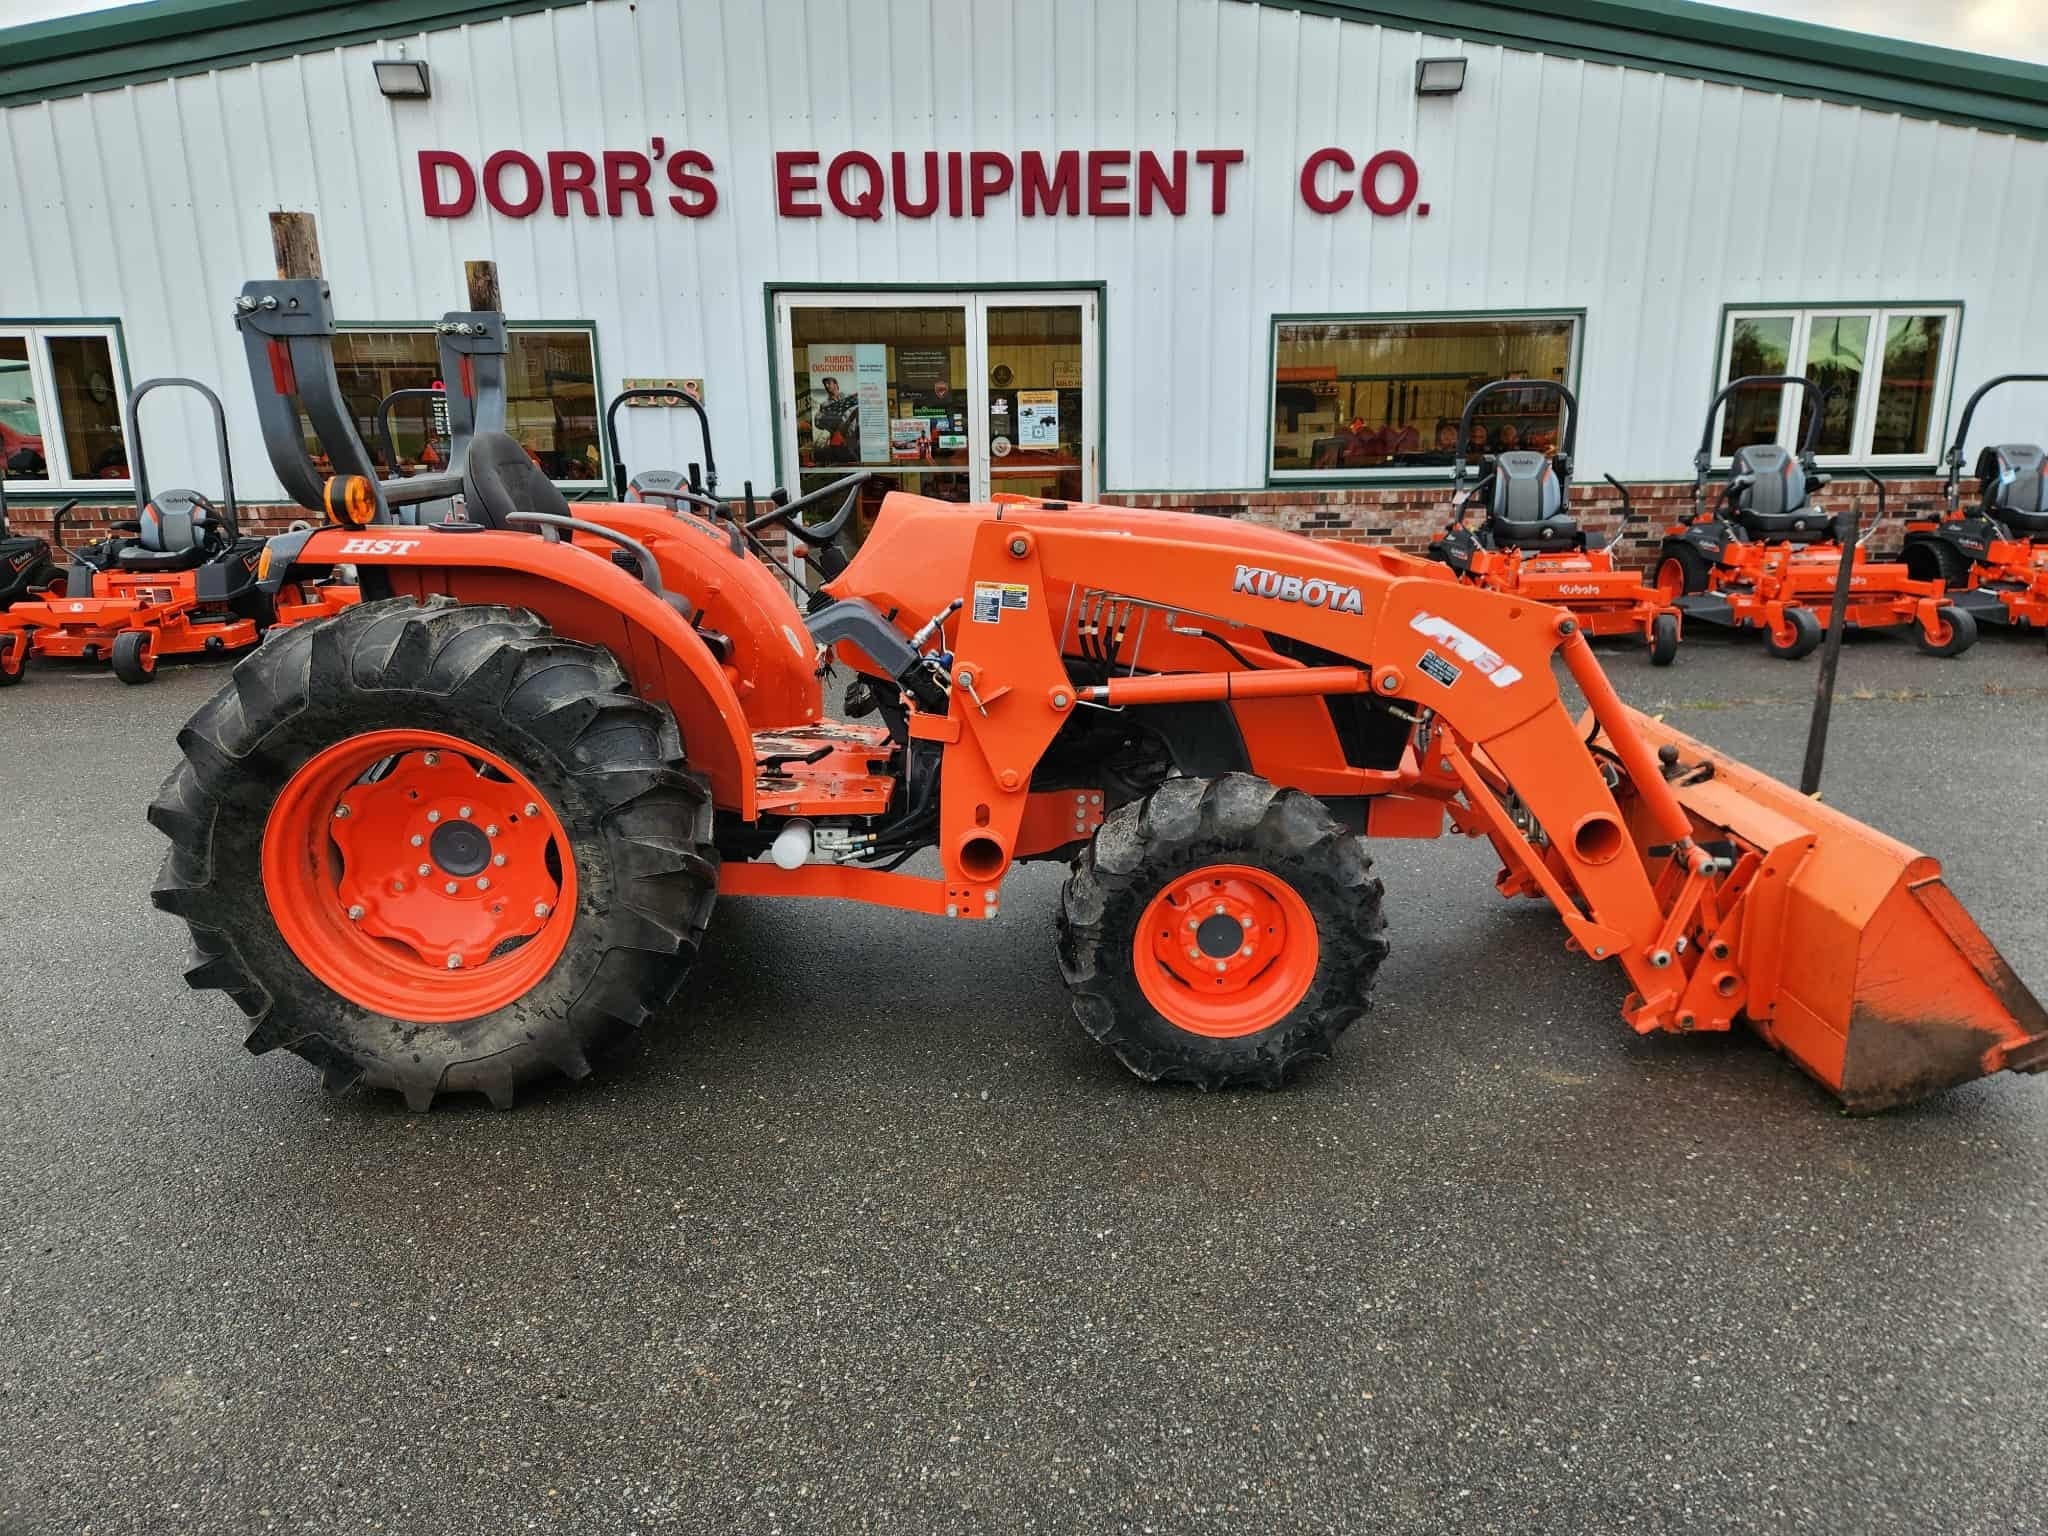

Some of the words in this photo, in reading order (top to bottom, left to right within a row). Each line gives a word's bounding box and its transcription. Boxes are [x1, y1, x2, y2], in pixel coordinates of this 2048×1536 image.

[419, 140, 716, 217] DORR'S
[777, 151, 1242, 222] EQUIPMENT
[1301, 149, 1428, 214] CO.
[340, 538, 421, 555] HST
[1232, 564, 1363, 616] KUBOTA
[1558, 583, 1600, 595] Kubota
